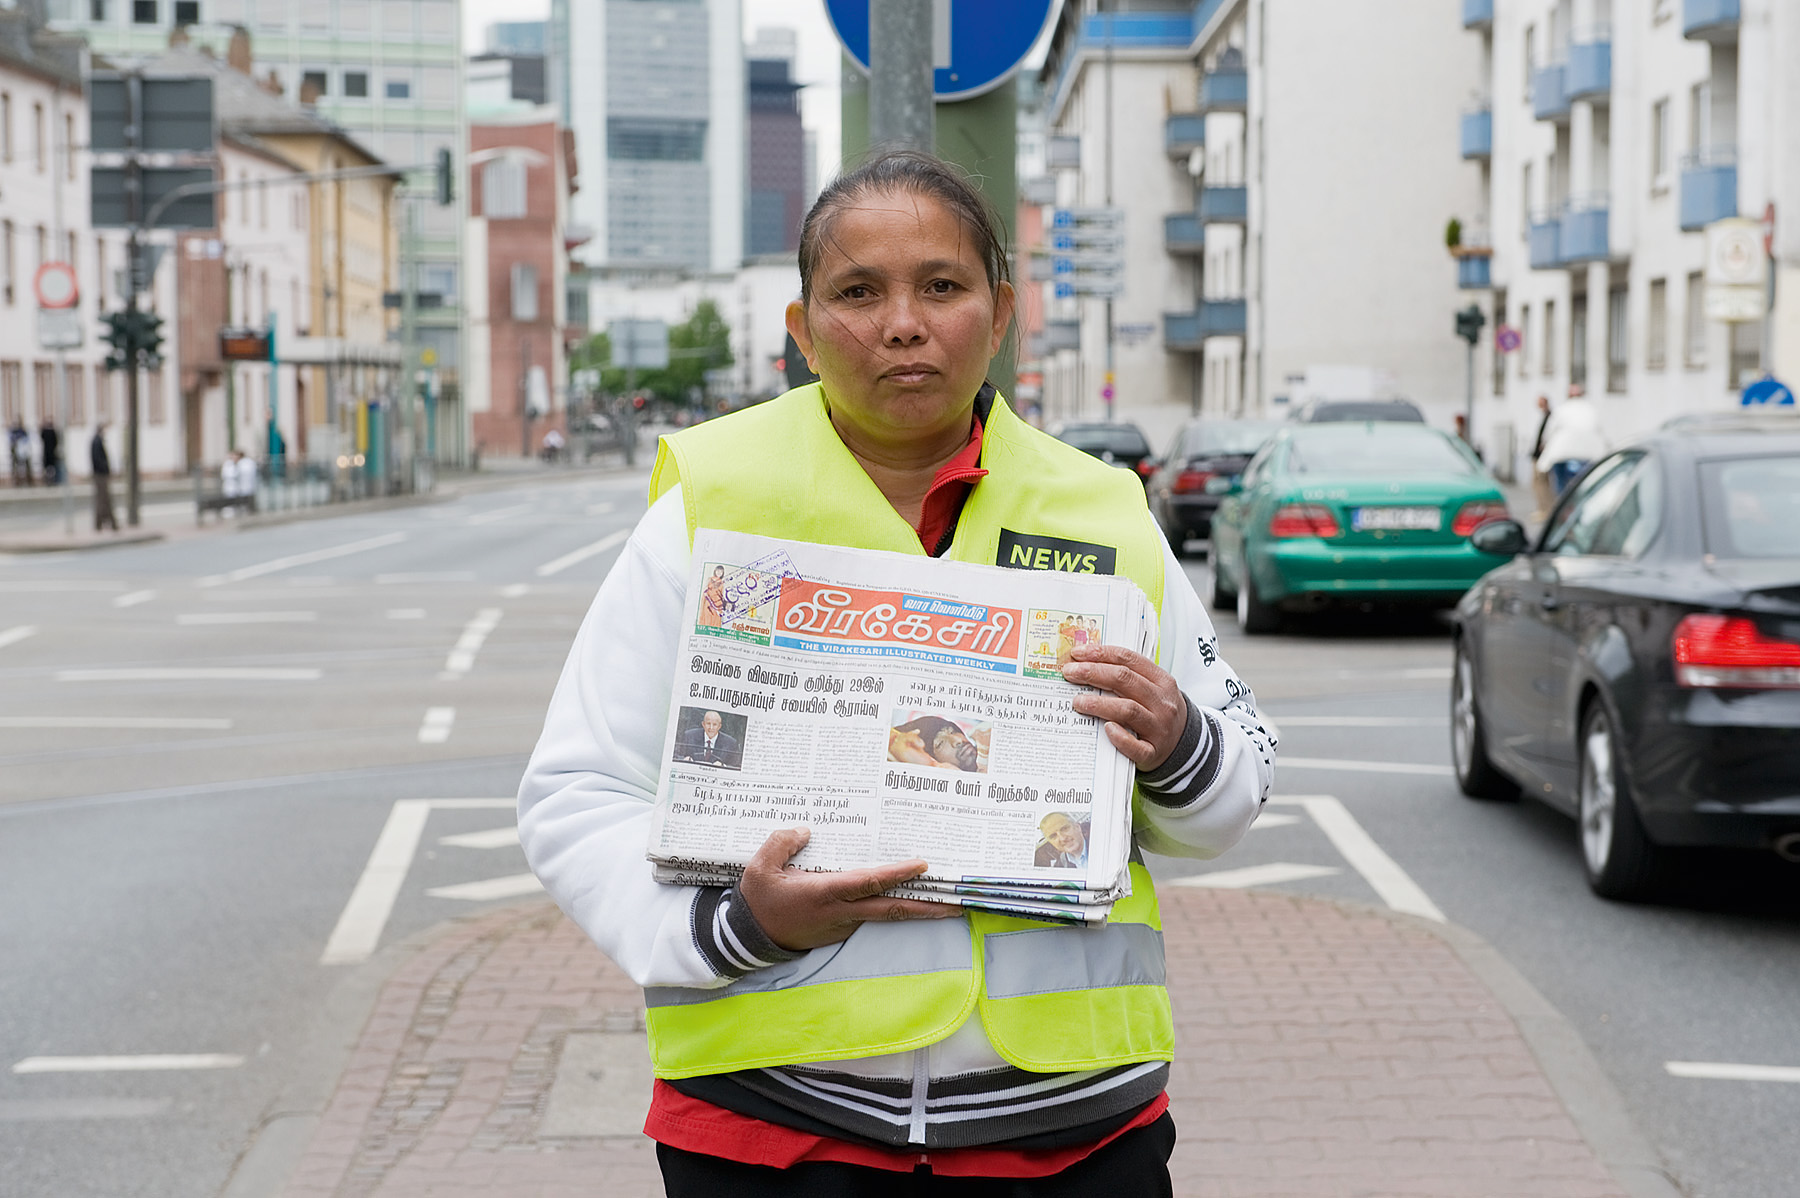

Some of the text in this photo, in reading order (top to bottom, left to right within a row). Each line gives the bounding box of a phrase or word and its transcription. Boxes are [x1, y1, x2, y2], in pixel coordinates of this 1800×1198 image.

[1009, 543, 1098, 575] NEWS
[784, 589, 1013, 655] வீரகேசரி
[903, 597, 986, 621] வார வெளியீடு
[1035, 611, 1048, 621] 63
[799, 642, 820, 651] THE
[822, 644, 883, 656] VIRAKESARI
[885, 648, 952, 663] ILLUSTRATED
[954, 657, 996, 670] WEEKLY
[690, 655, 884, 695] இலங்கை விவகாரம் குறித்து 29இல்
[689, 682, 880, 719] ஐ.நா.பாதுகாப்புச் சபையில் ஆராய்வு
[896, 694, 923, 706] முடிவு
[985, 706, 1027, 720] இருந்தால்
[885, 771, 1092, 804] நிரந்தரமான போர் நிறுத்தமே அவசியம்
